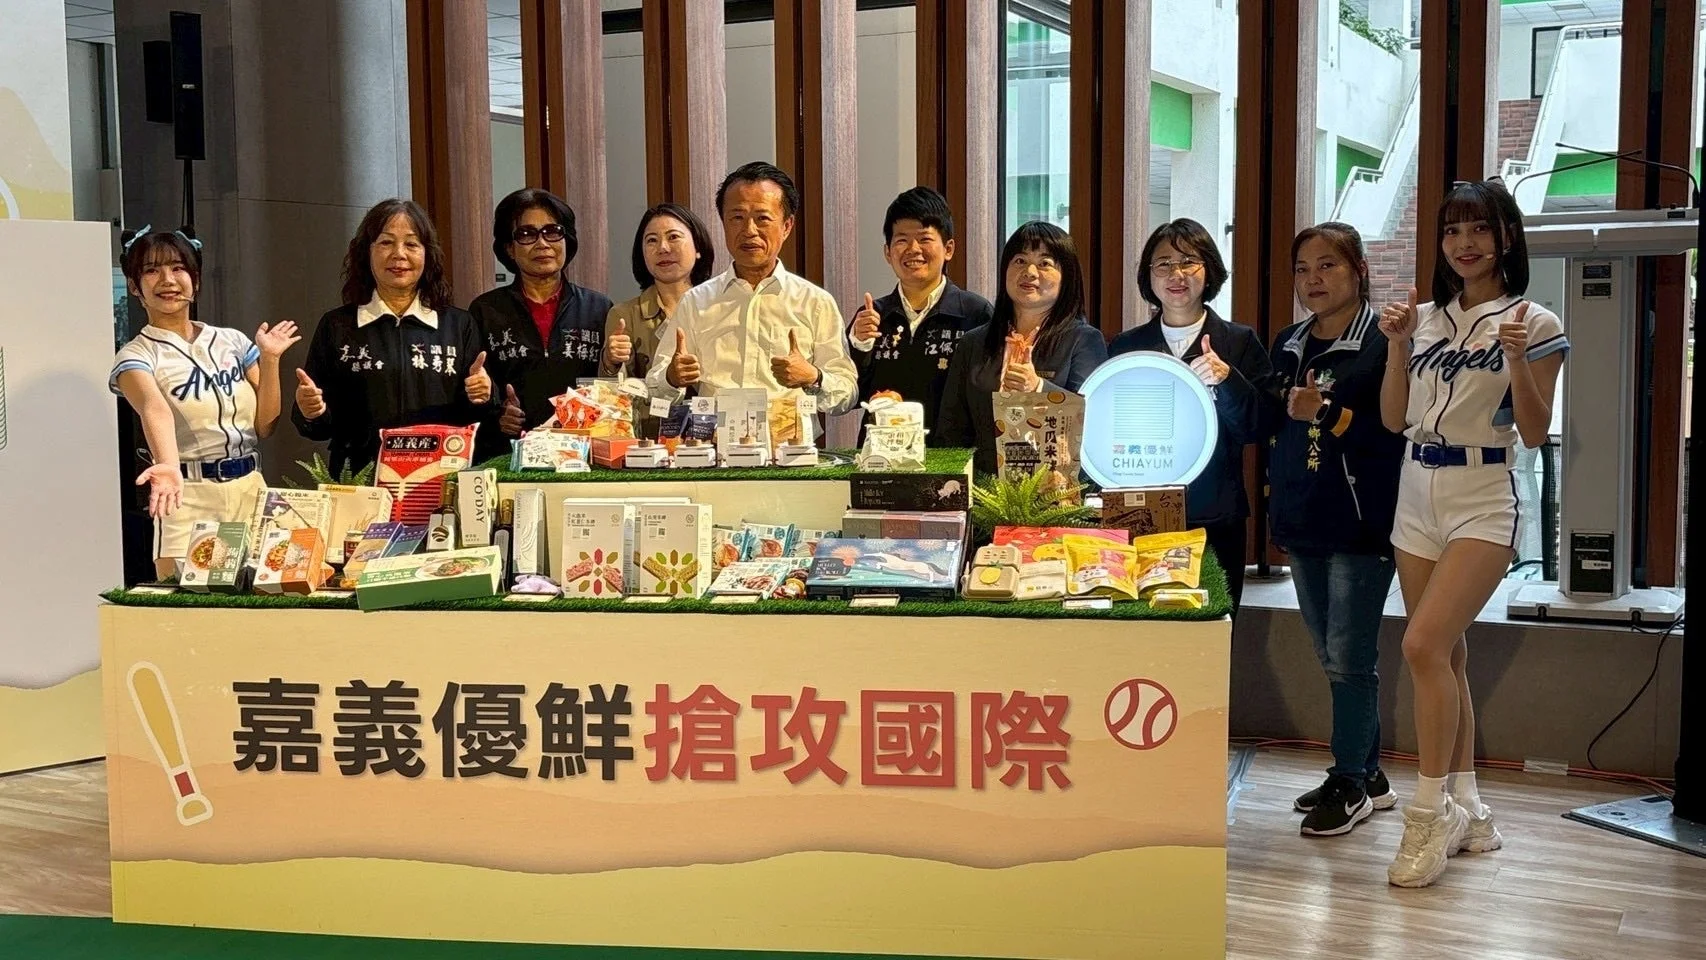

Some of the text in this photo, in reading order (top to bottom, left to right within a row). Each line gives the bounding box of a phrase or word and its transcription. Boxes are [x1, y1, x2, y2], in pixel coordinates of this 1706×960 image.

[925, 341, 959, 355] 江佩
[1409, 337, 1506, 383] Angels
[171, 356, 245, 401] Angel
[391, 437, 433, 449] 嘉義產
[1112, 457, 1173, 469] CHIAYUM
[473, 476, 485, 523] CO'DAY
[232, 677, 1073, 791] 嘉義優鮮搶攻國際
